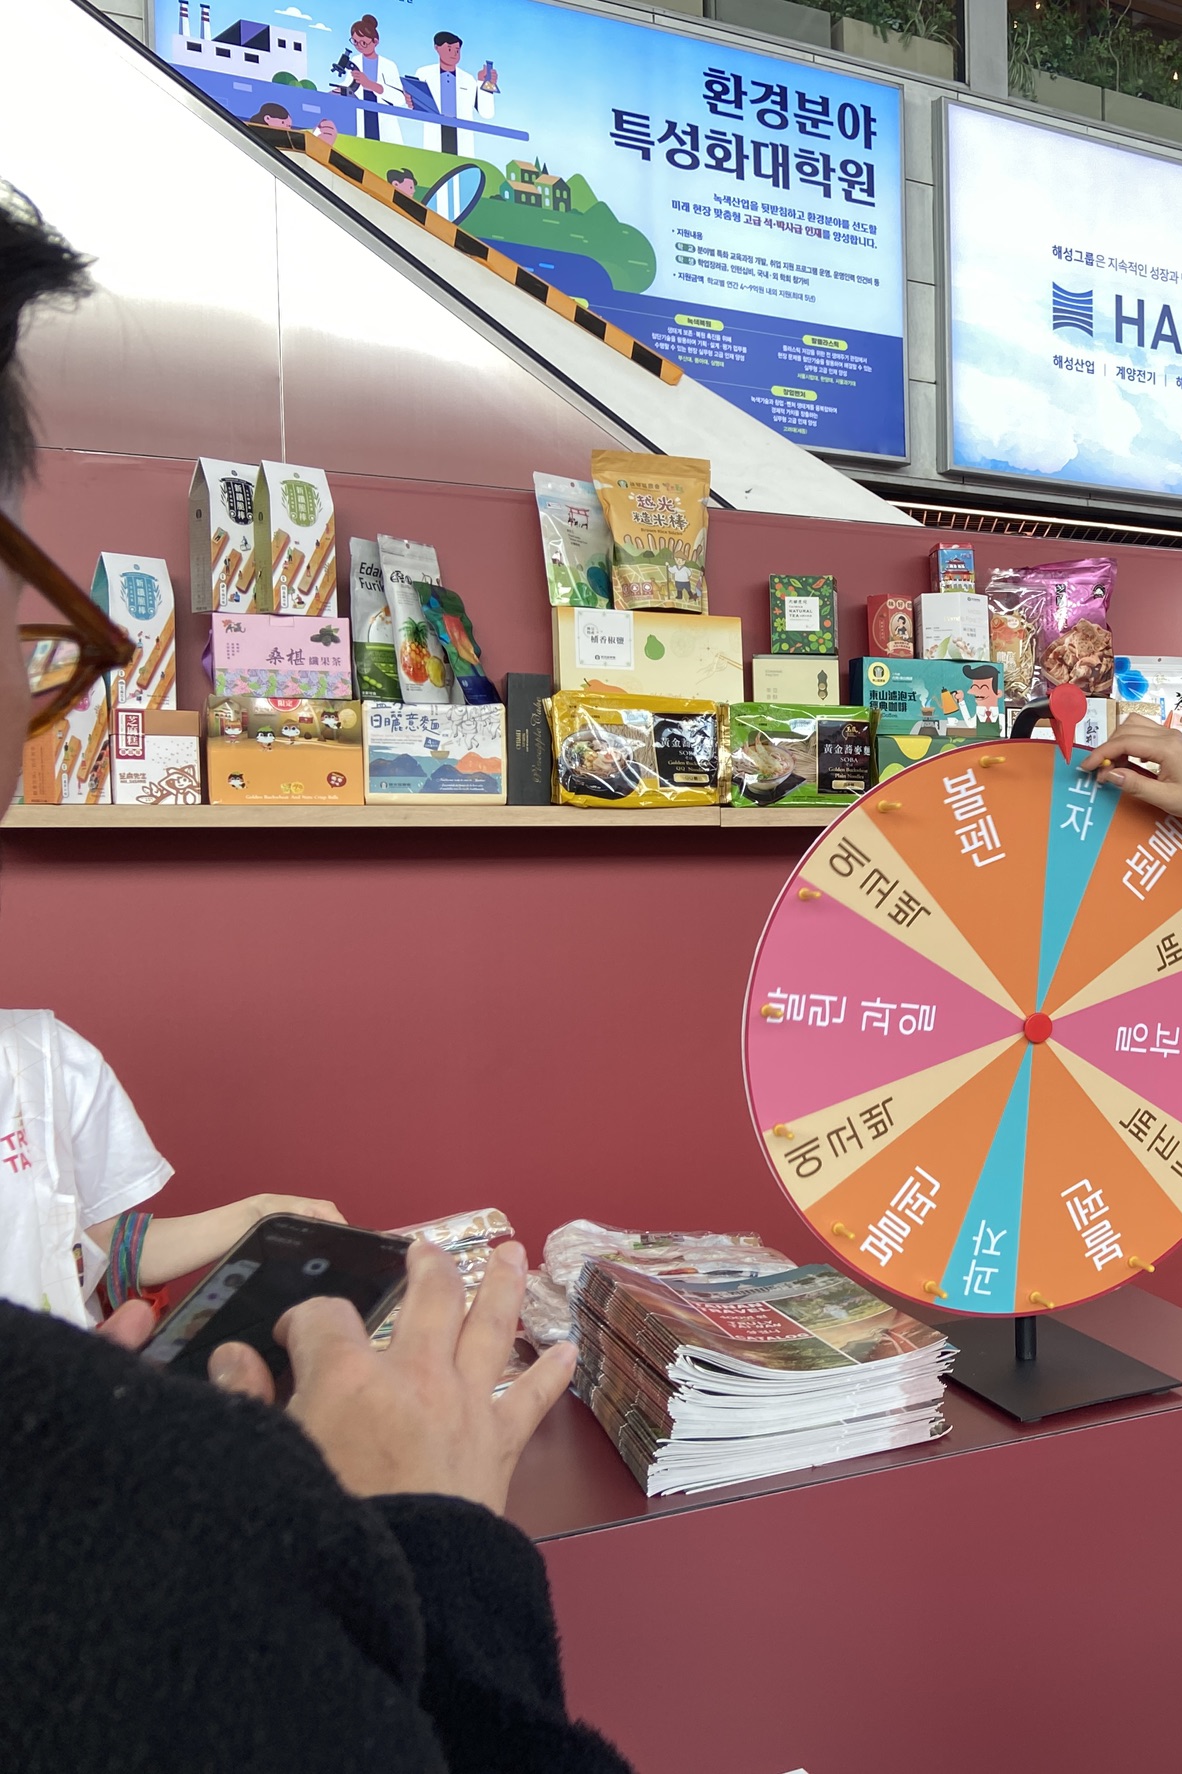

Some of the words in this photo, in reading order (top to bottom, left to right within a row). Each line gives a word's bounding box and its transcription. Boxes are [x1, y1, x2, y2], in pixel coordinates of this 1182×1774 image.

[702, 66, 877, 150] 환경분야
[609, 107, 876, 207] 특성화대학원
[671, 200, 690, 213] 미래
[693, 204, 711, 217] 현장
[713, 208, 741, 222] 맞춤형
[743, 213, 762, 227] 고급
[805, 226, 831, 240] 인재를
[832, 231, 878, 249] 양성합니다.
[713, 193, 759, 212] 녹색산업을
[761, 203, 806, 221] 뒷받침하고
[807, 212, 850, 230] 환경분야를
[852, 221, 877, 235] 선도할
[1052, 244, 1106, 269] 해성그룹은
[1108, 257, 1148, 278] 지속적인
[1150, 266, 1179, 284] 성장과
[1053, 354, 1095, 375] 해성산업
[1115, 365, 1156, 385] 계양전기
[943, 768, 1006, 868] 볼펜
[1059, 765, 1106, 841] 과자
[829, 836, 931, 928] 에코백
[766, 987, 847, 1028] 말린
[861, 996, 937, 1036] 과일
[1115, 1022, 1181, 1059] 과일
[785, 1096, 896, 1179] 에코백
[859, 1165, 942, 1267] 볼펜
[1060, 1178, 1125, 1272] 볼펜
[962, 1218, 1008, 1298] 과자
